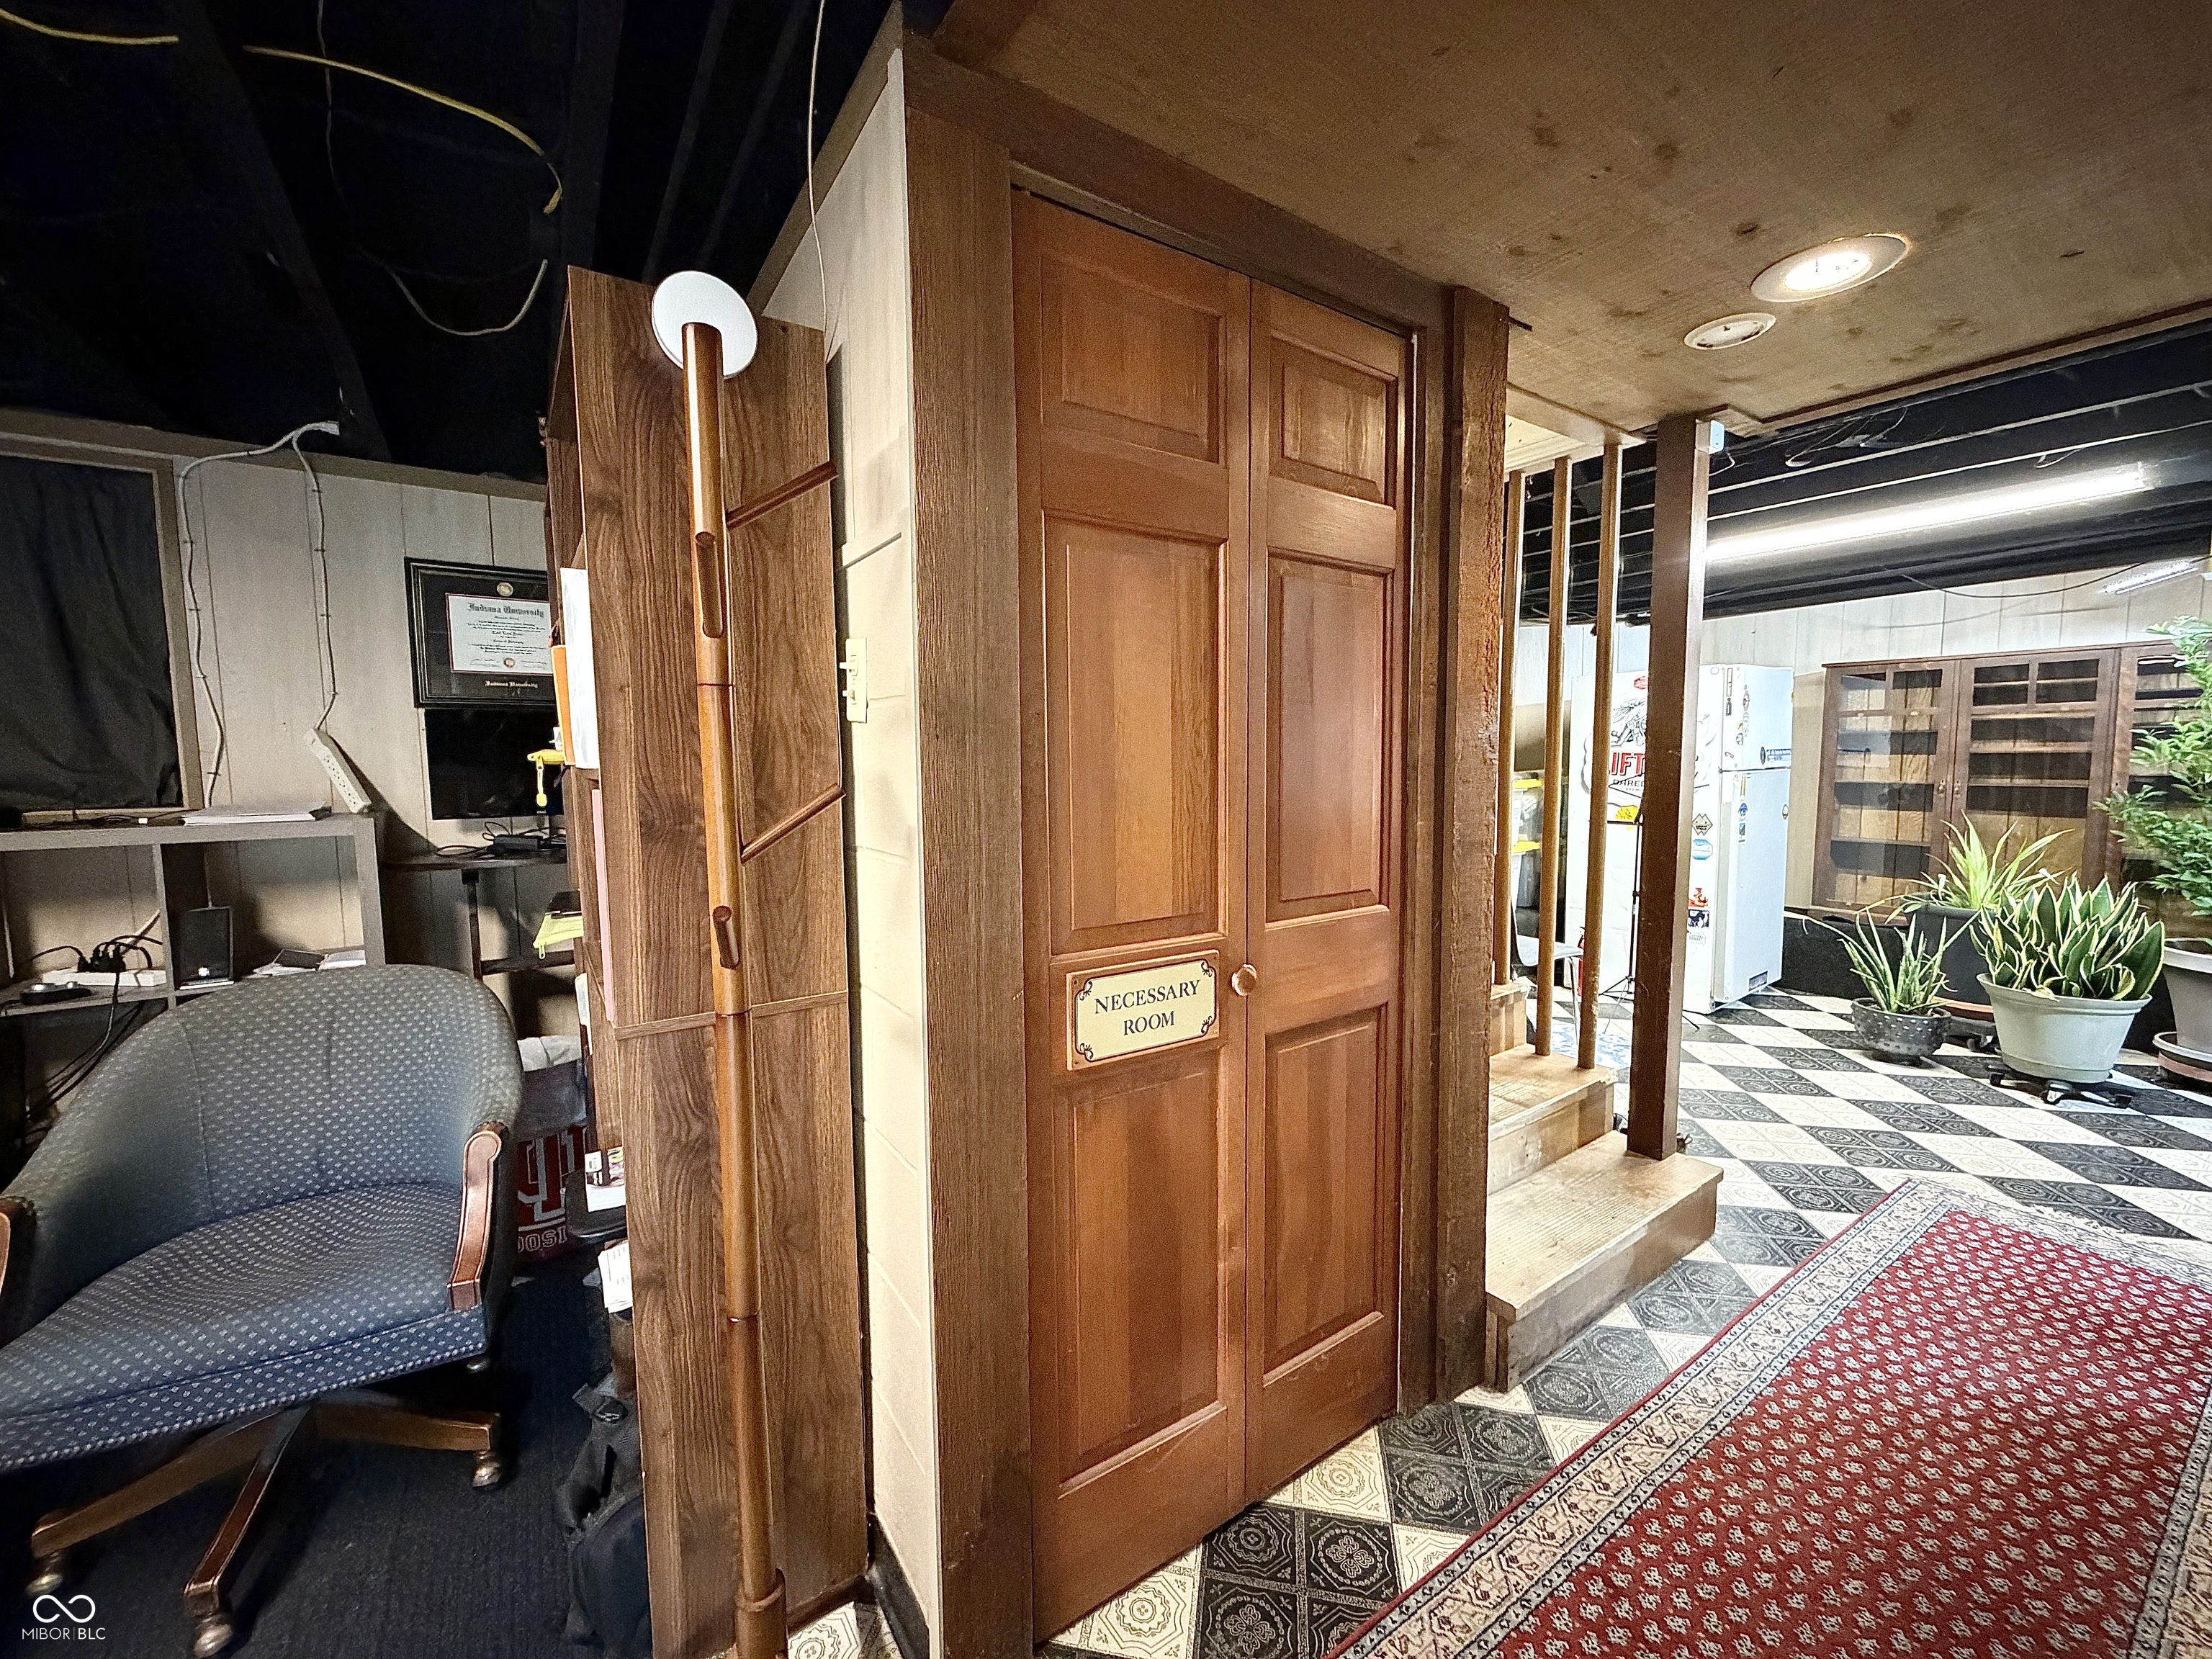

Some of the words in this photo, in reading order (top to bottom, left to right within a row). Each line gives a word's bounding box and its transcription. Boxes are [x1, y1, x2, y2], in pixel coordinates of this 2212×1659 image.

[468, 602, 502, 613] Indiana
[503, 605, 545, 618] University
[1611, 752, 1645, 775] IFT
[1094, 979, 1201, 1014] NECESSARY
[1123, 1010, 1175, 1036] ROOM
